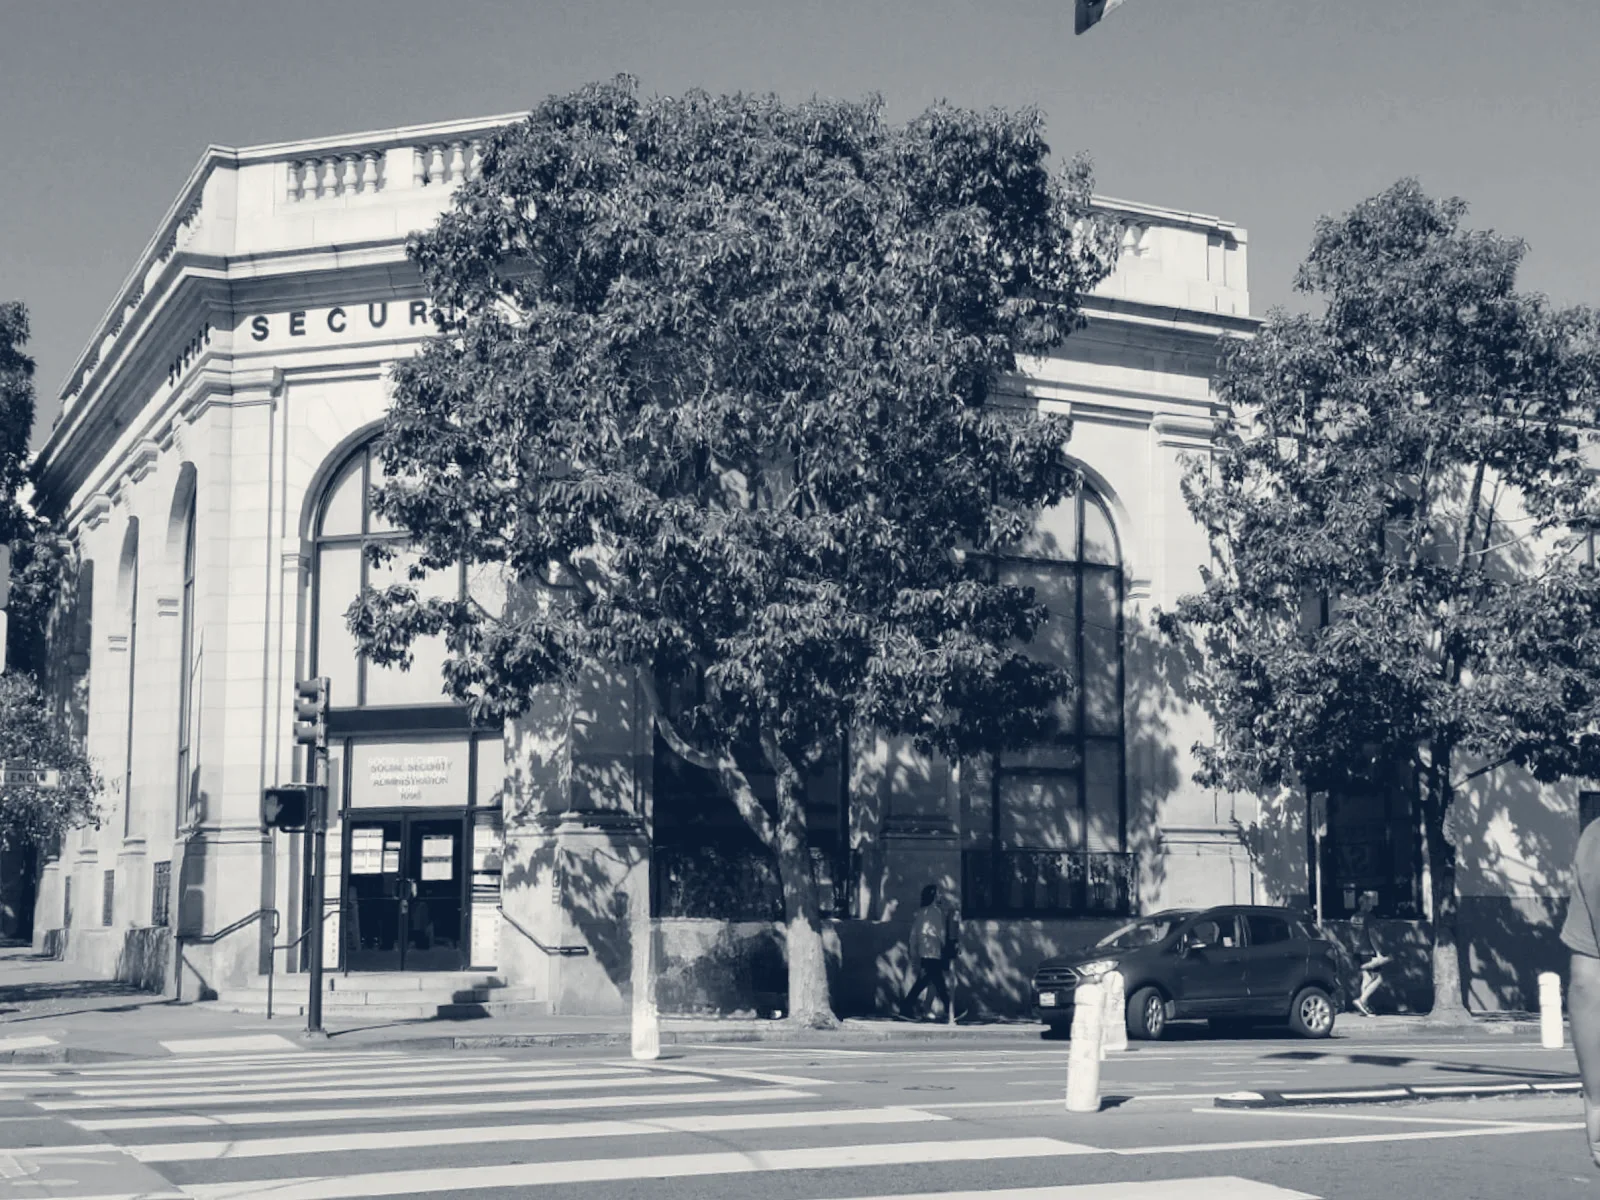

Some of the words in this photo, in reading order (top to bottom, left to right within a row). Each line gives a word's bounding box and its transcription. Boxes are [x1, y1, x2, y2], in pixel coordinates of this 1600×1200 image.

[369, 758, 403, 773] SOCIAL
[405, 756, 452, 772] SECURITY
[371, 772, 448, 786] ADMINISTRATION
